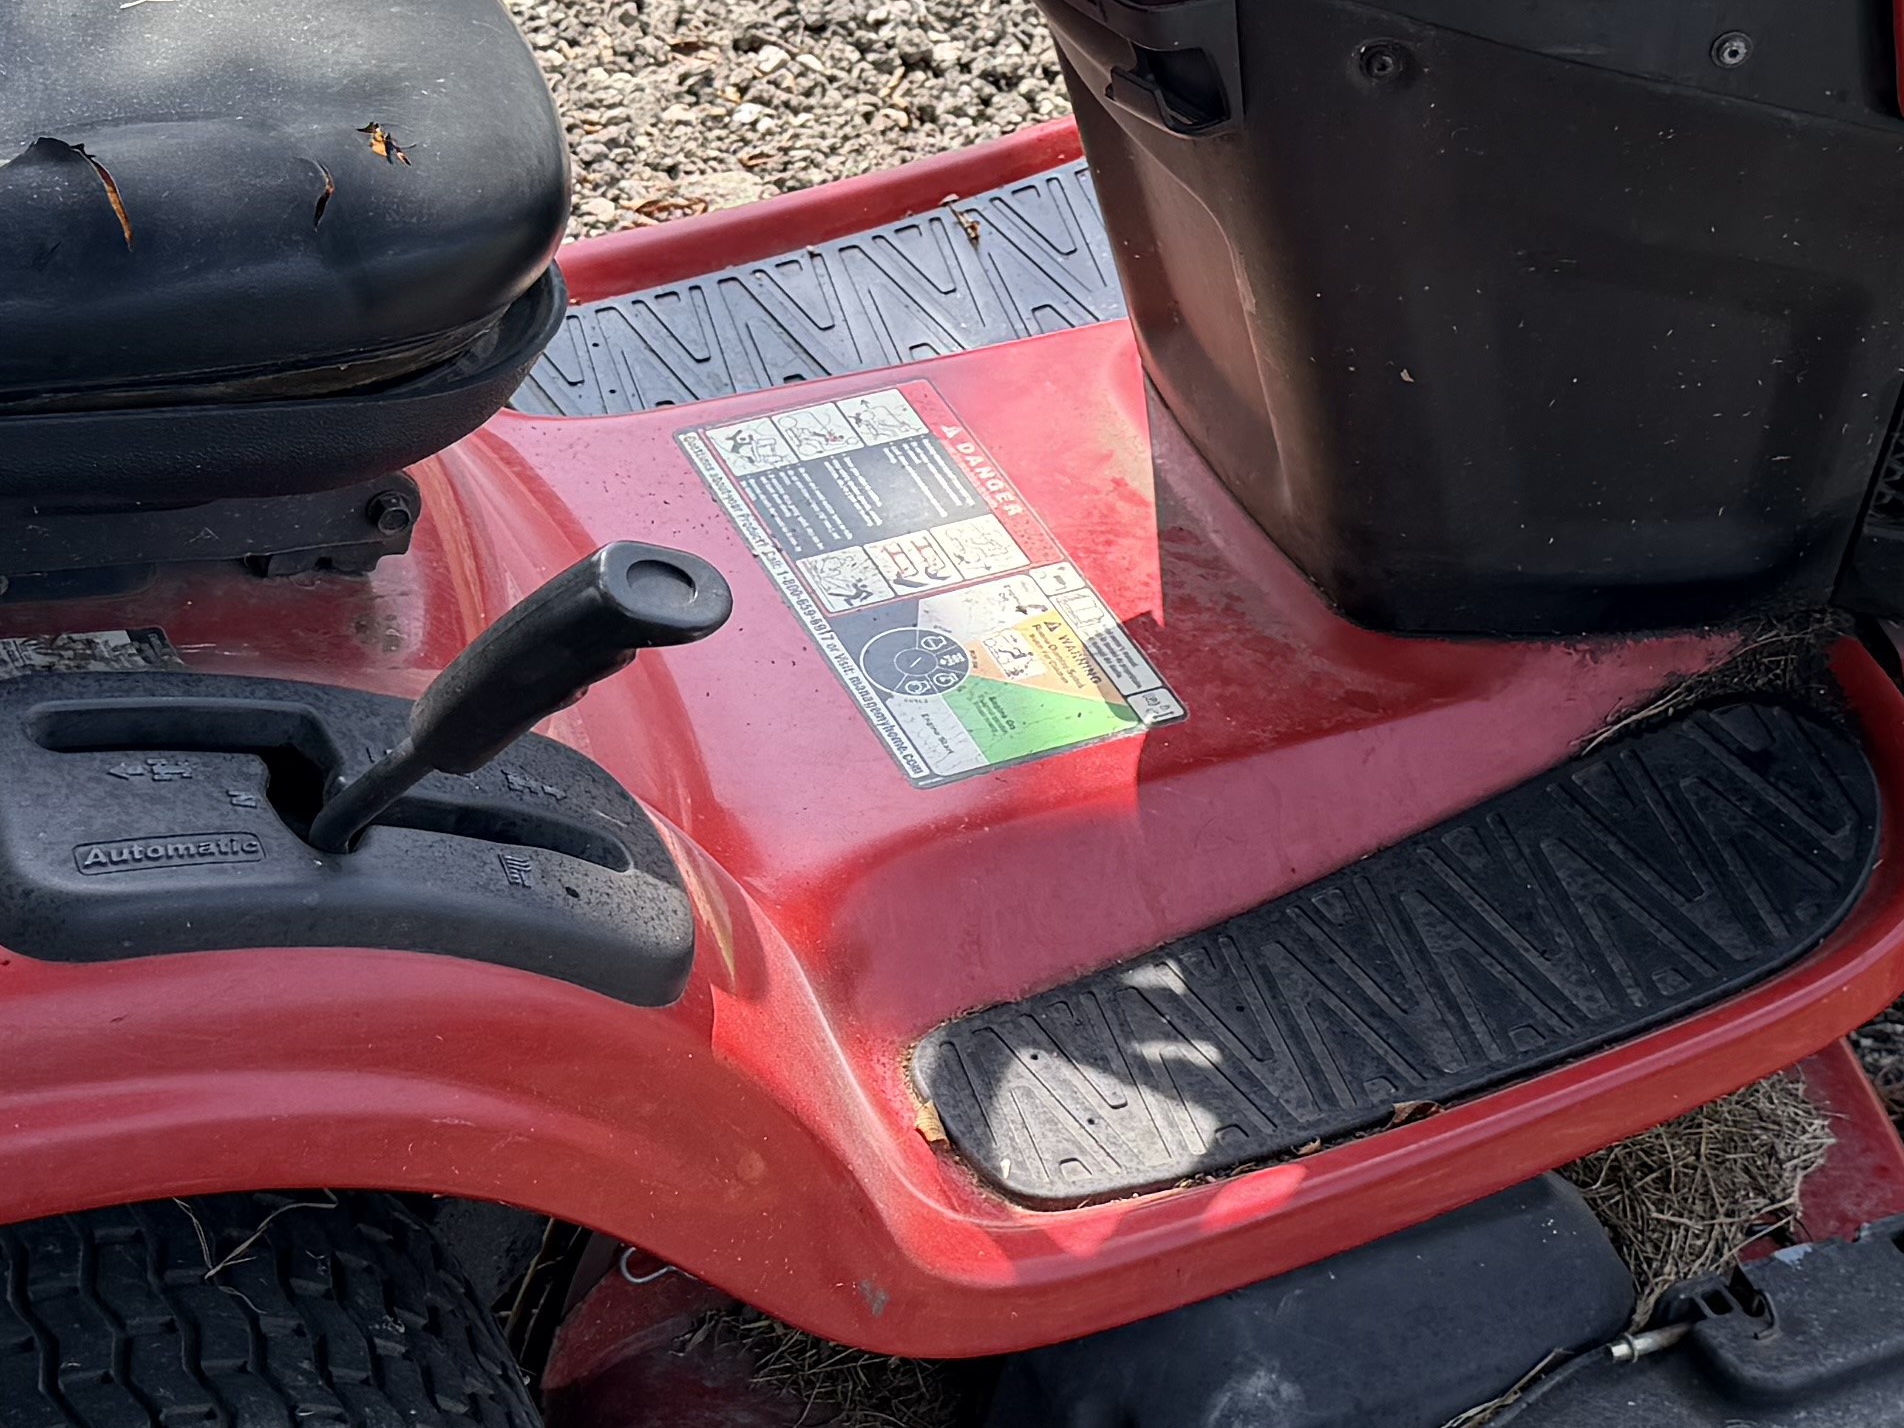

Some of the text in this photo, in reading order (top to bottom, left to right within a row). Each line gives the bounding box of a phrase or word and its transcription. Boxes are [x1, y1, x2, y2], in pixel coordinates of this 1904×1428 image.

[955, 441, 1025, 516] DANGER
[1056, 634, 1103, 684] WARNING
[845, 675, 927, 775] managemyhome.com
[83, 838, 260, 869] Automatic
